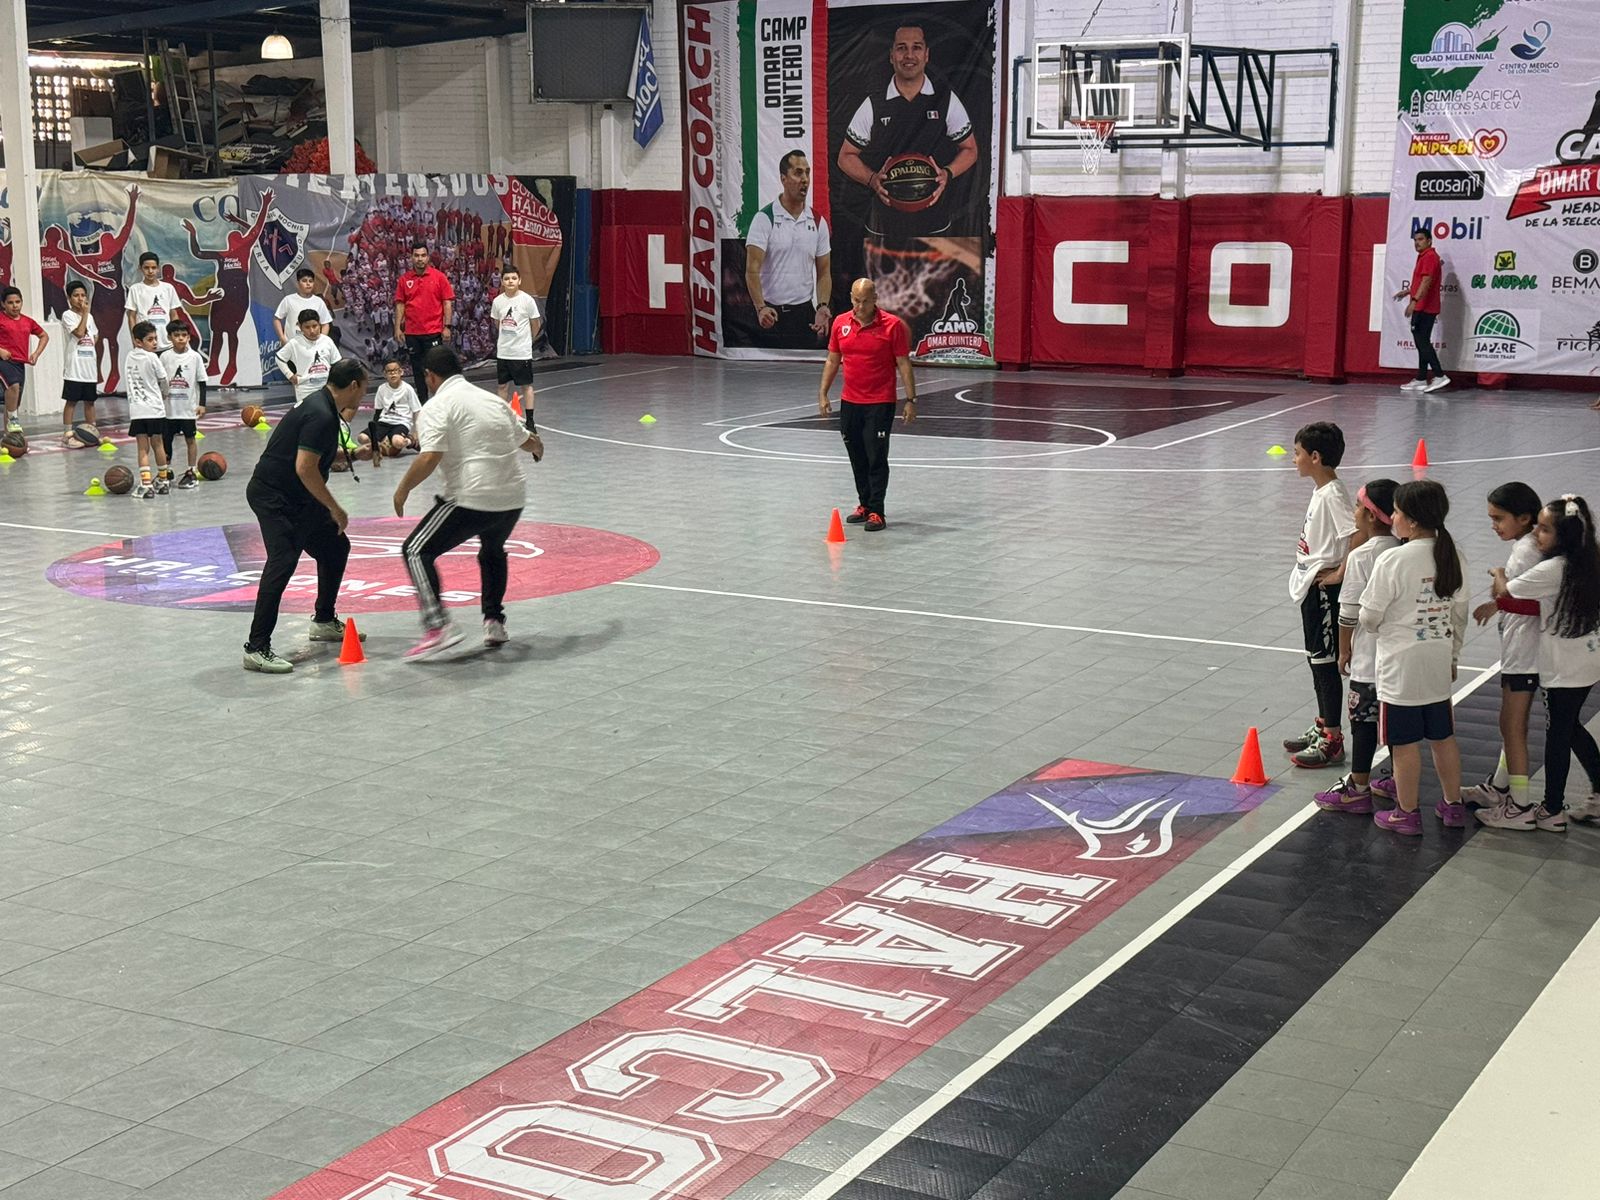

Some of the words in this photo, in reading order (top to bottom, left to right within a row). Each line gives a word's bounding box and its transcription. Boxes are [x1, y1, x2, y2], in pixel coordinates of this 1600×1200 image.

[761, 16, 806, 41] CAMP
[1411, 55, 1443, 63] CIUDAD
[1445, 52, 1494, 61] MILLENNIAL
[1500, 62, 1528, 70] CENTRO
[1529, 61, 1559, 69] MEDICO
[713, 50, 722, 119] MEXICANA
[764, 46, 781, 108] OMAR
[687, 6, 714, 188] COACH
[782, 45, 805, 138] QUINTERO
[1466, 89, 1521, 101] PACIFICA
[1424, 101, 1471, 111] SOLUTIONS
[1491, 101, 1501, 110] DE
[890, 165, 931, 180] SPALDING
[1539, 169, 1591, 195] OMAR
[1410, 216, 1483, 240] Mobil
[1525, 218, 1540, 227] DE
[1542, 217, 1558, 227] LA
[693, 206, 717, 353] HEAD
[934, 321, 976, 333] CAMP
[927, 335, 948, 347] OMAR
[948, 335, 982, 347] QUINTERO
